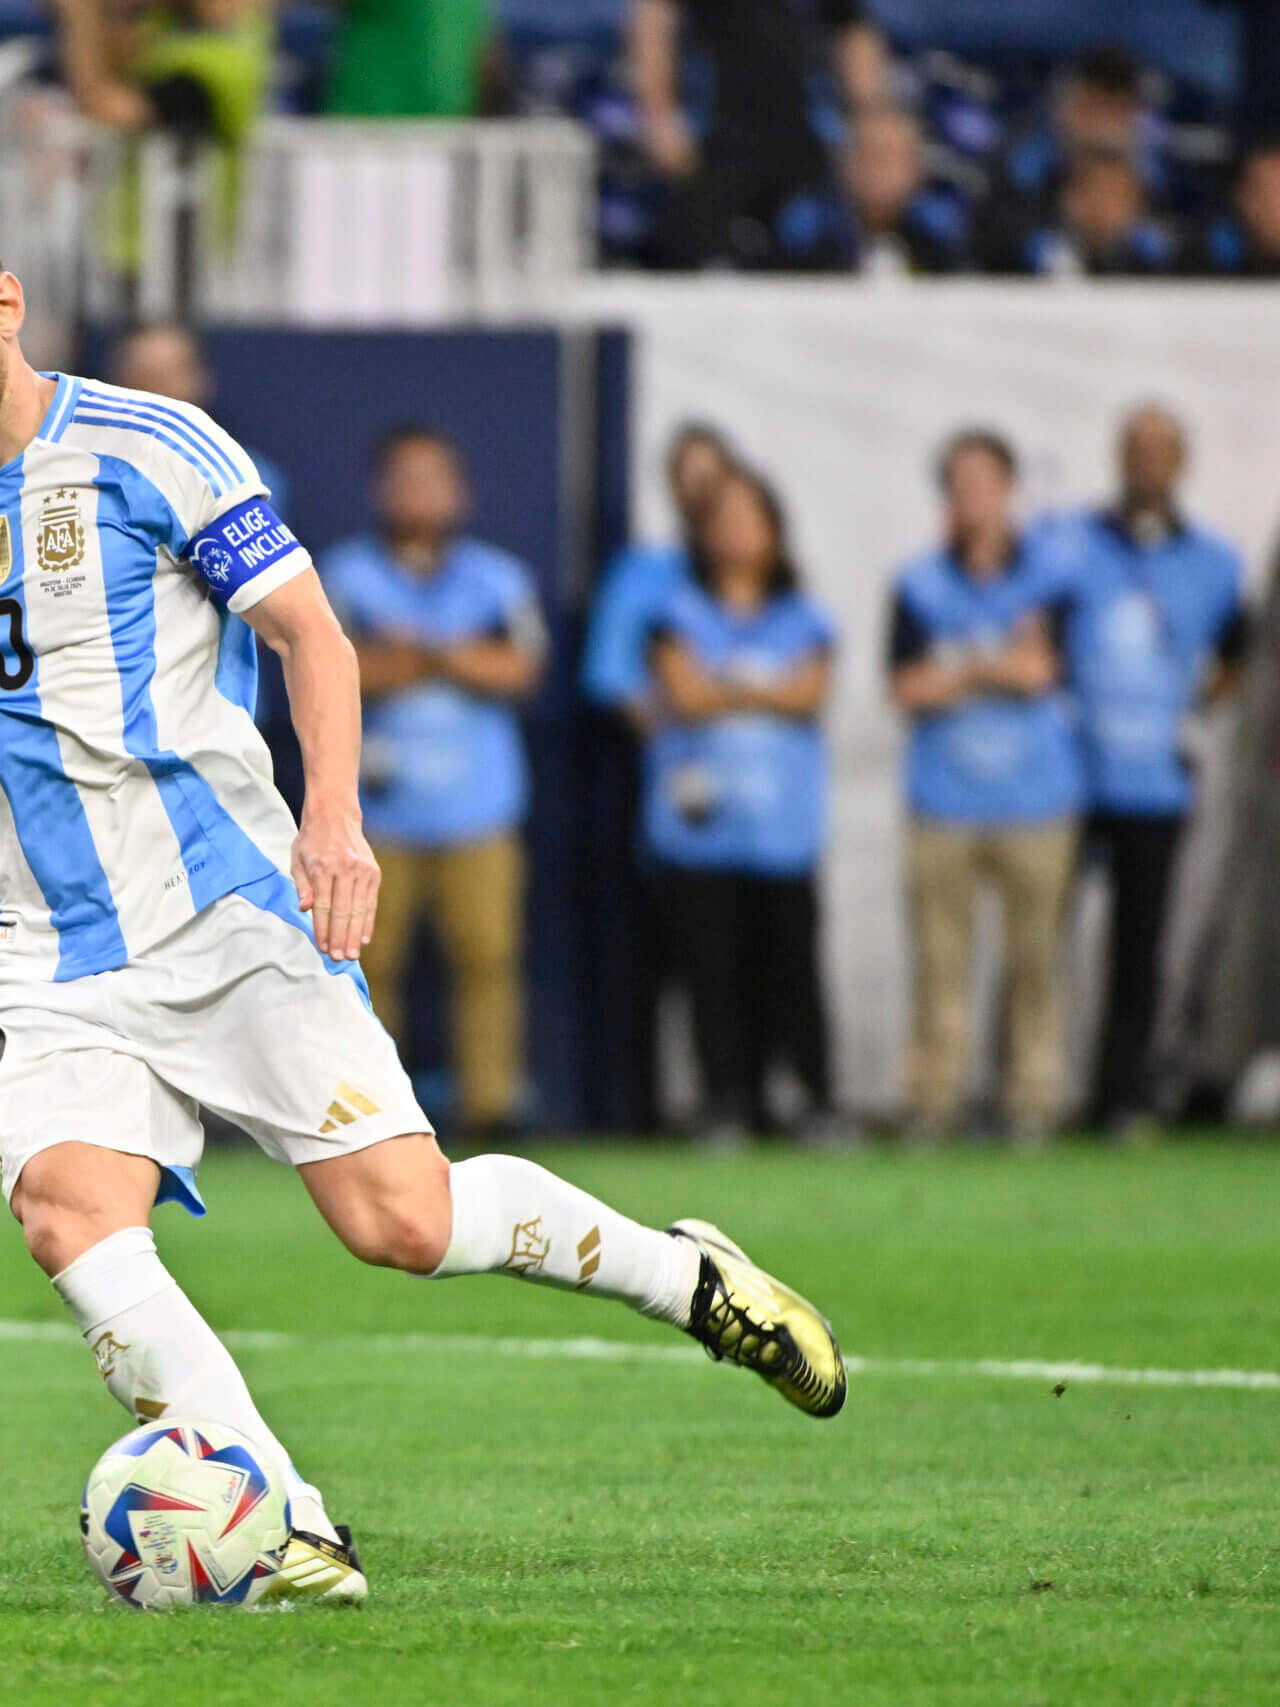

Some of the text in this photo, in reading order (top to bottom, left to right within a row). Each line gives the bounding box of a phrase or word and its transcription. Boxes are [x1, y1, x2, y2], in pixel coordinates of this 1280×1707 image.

[45, 522, 75, 553] AFA
[222, 507, 270, 547] ELIGE
[238, 524, 298, 568] INCLU
